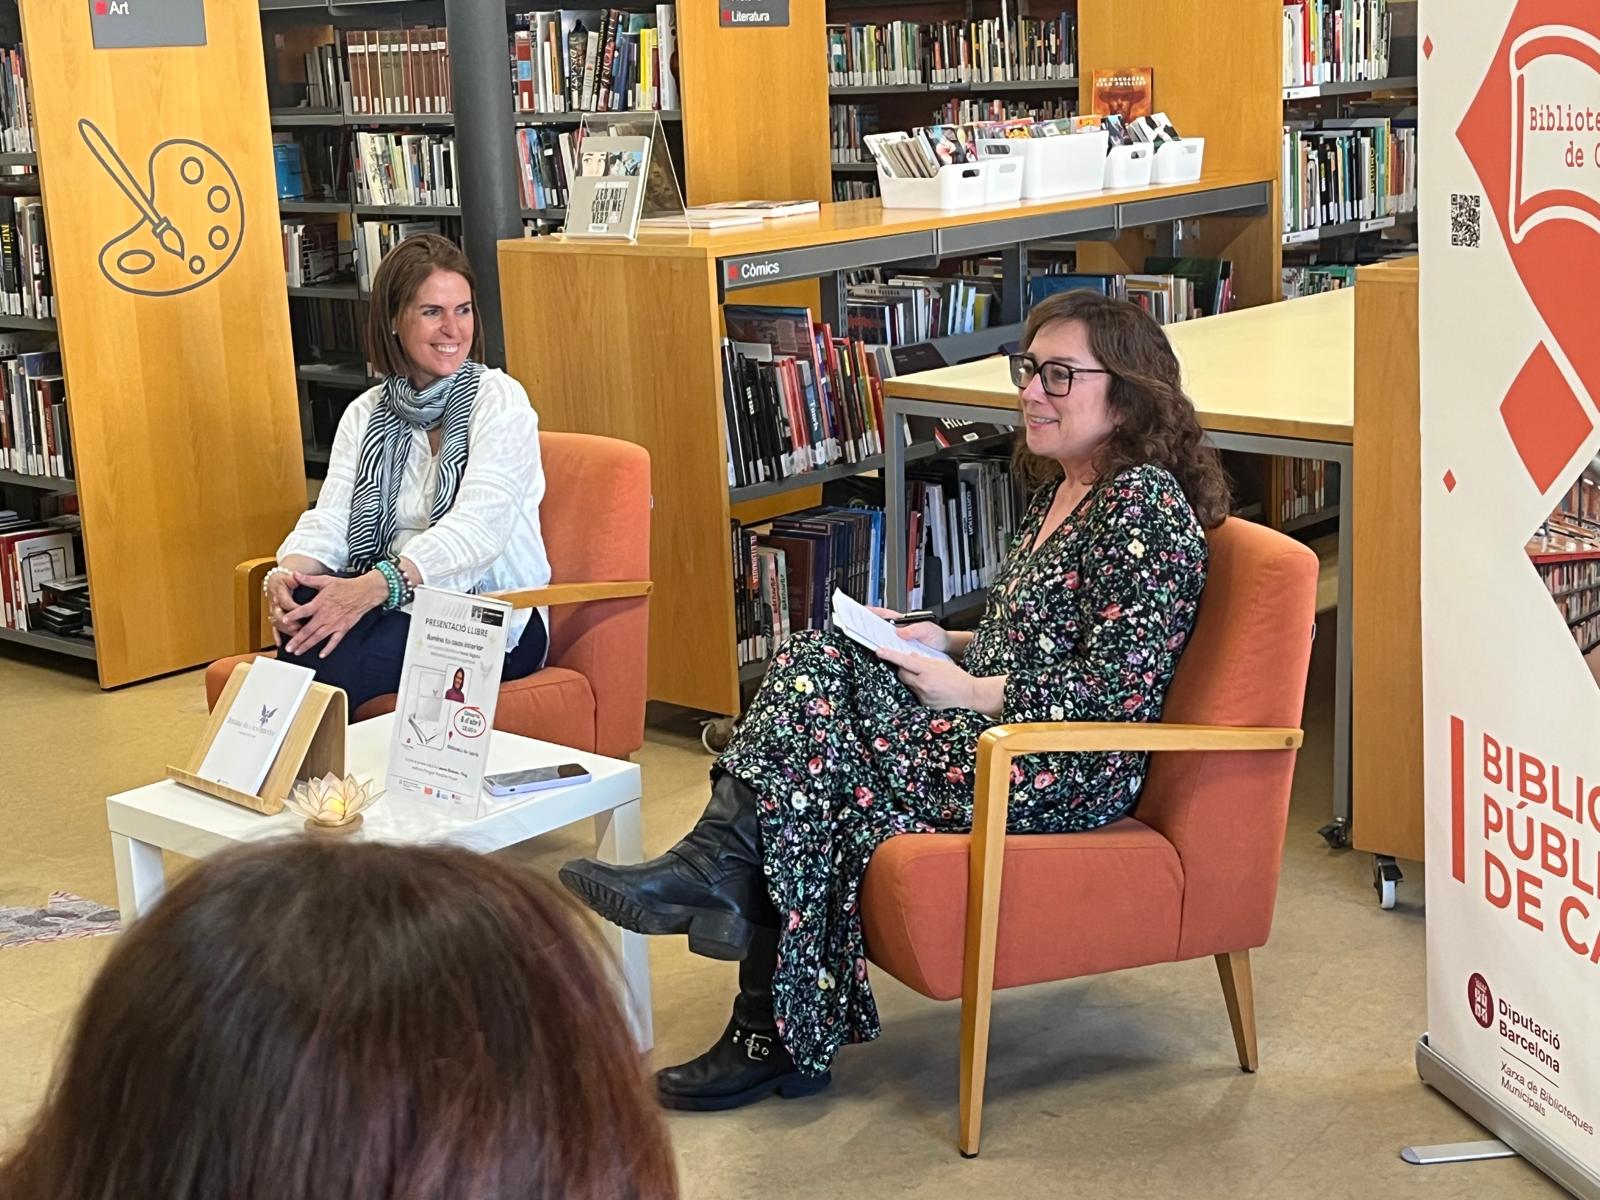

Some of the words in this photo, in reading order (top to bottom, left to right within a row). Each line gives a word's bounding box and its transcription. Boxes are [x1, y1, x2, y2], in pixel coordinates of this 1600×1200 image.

[109, 0, 130, 15] Art
[731, 10, 770, 22] Literatura
[1565, 140, 1584, 167] de
[741, 261, 780, 278] Còmics
[425, 617, 467, 633] PRESENTACIÓ
[467, 626, 489, 638] LLIBRE
[1485, 849, 1544, 932] DE
[1499, 998, 1561, 1050] Diputació
[1499, 1019, 1560, 1073] Barcelona
[1501, 1076, 1546, 1117] Municipals
[1501, 1061, 1525, 1085] Xarxa
[1527, 1080, 1538, 1094] de
[1540, 1088, 1594, 1135] Biblioteques
